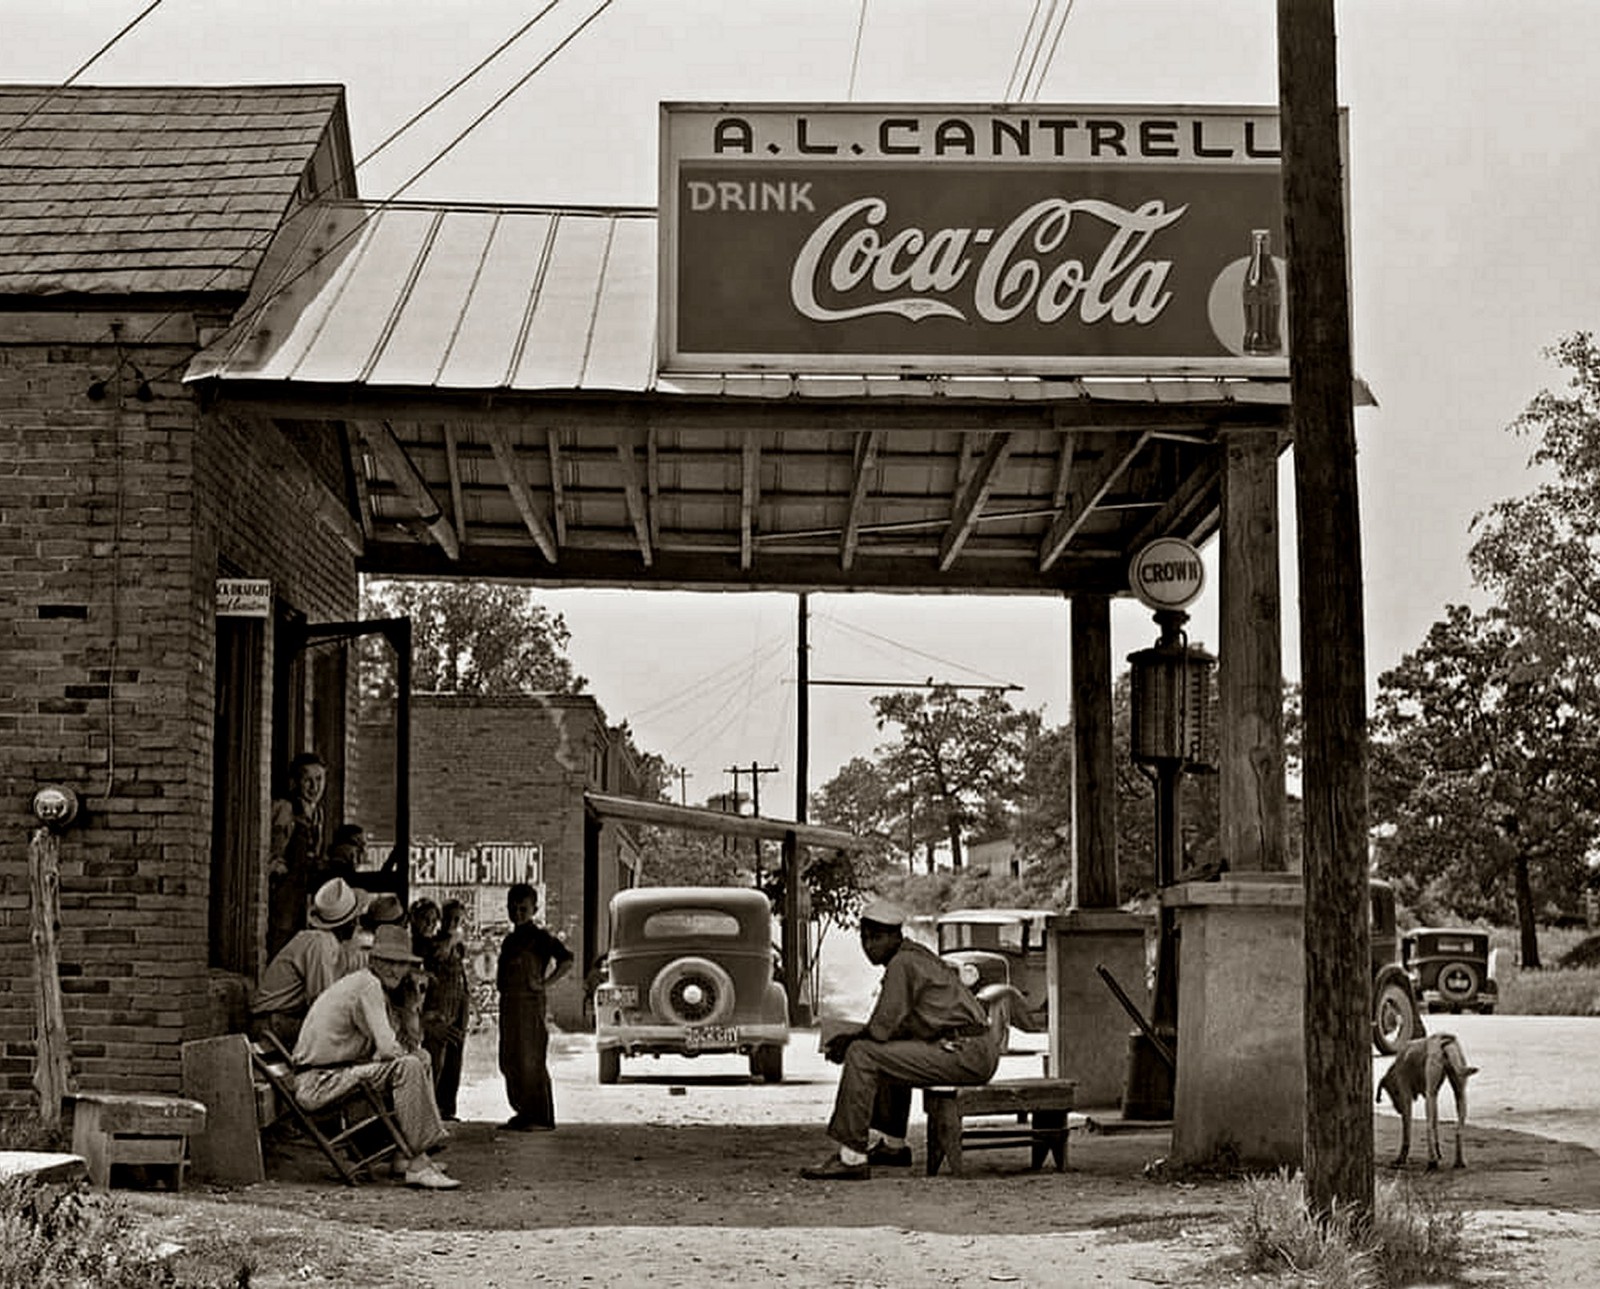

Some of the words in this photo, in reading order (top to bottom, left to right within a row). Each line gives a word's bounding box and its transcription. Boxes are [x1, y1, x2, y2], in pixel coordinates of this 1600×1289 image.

[687, 181, 815, 212] DRINK
[791, 197, 1190, 324] Coca-Cola
[1141, 561, 1198, 584] CROWN
[481, 847, 538, 884] SHOWS
